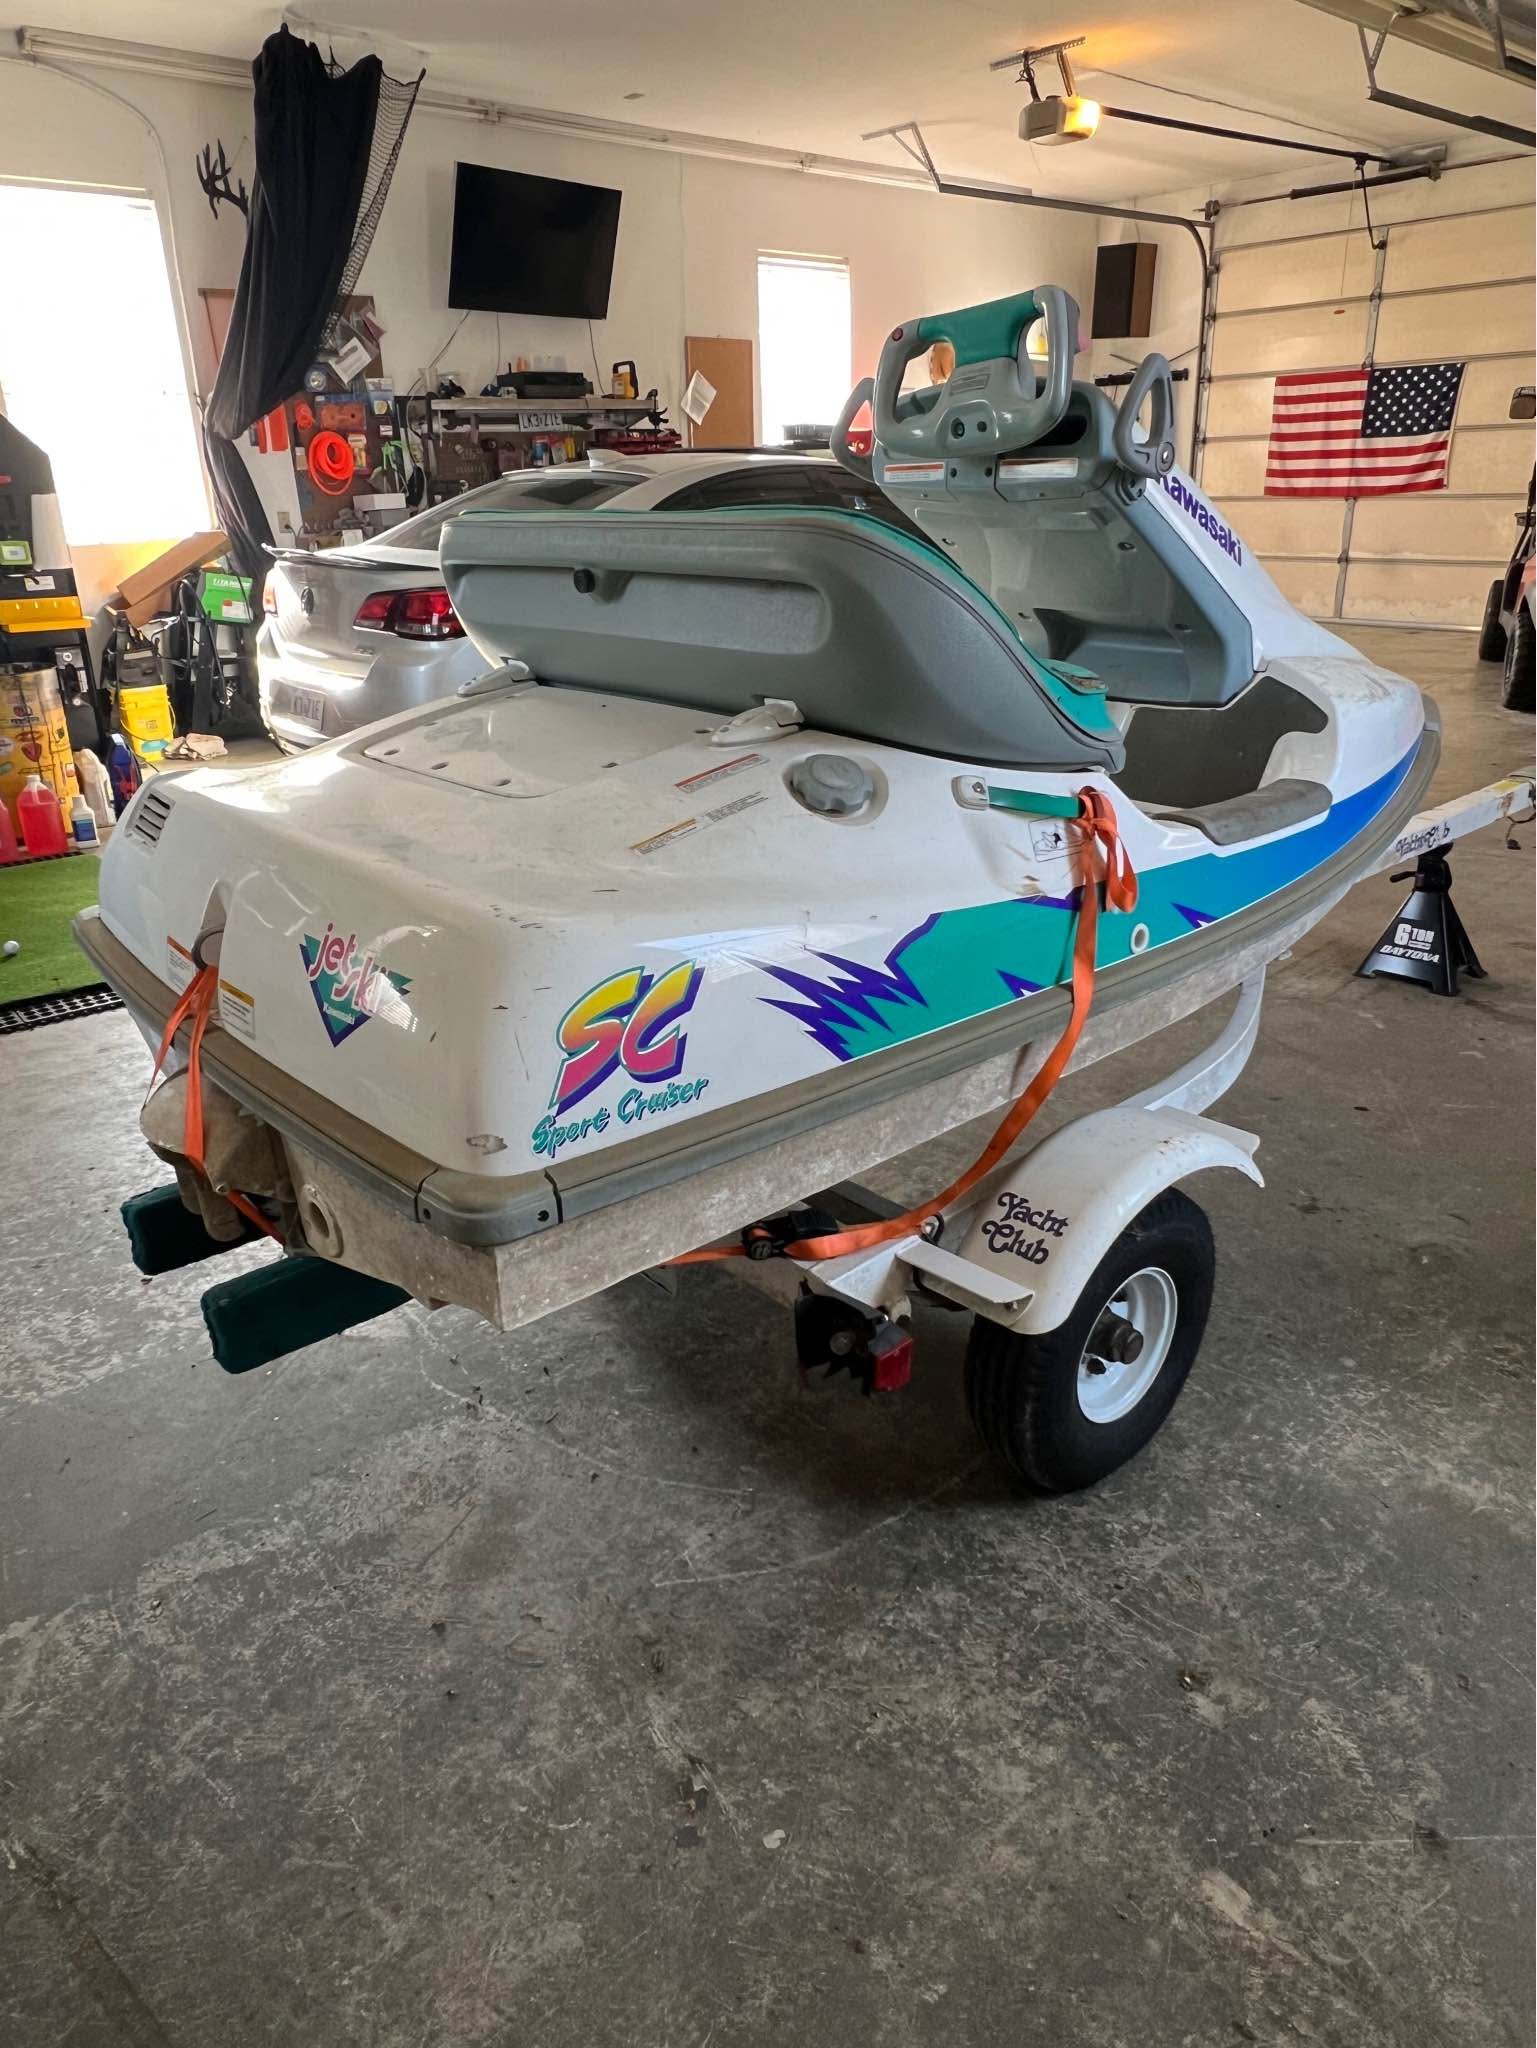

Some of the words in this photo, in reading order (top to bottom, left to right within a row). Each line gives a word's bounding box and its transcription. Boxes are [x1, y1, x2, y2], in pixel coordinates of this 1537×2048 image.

[309, 922, 357, 980] jet
[1380, 944, 1440, 963] DAYTONA
[1394, 923, 1412, 946] 6
[548, 958, 705, 1118] SC
[531, 1107, 611, 1159] Sport
[617, 1077, 709, 1124] Cruiser
[997, 1191, 1069, 1238] Yacht
[981, 1219, 1050, 1265] Club
